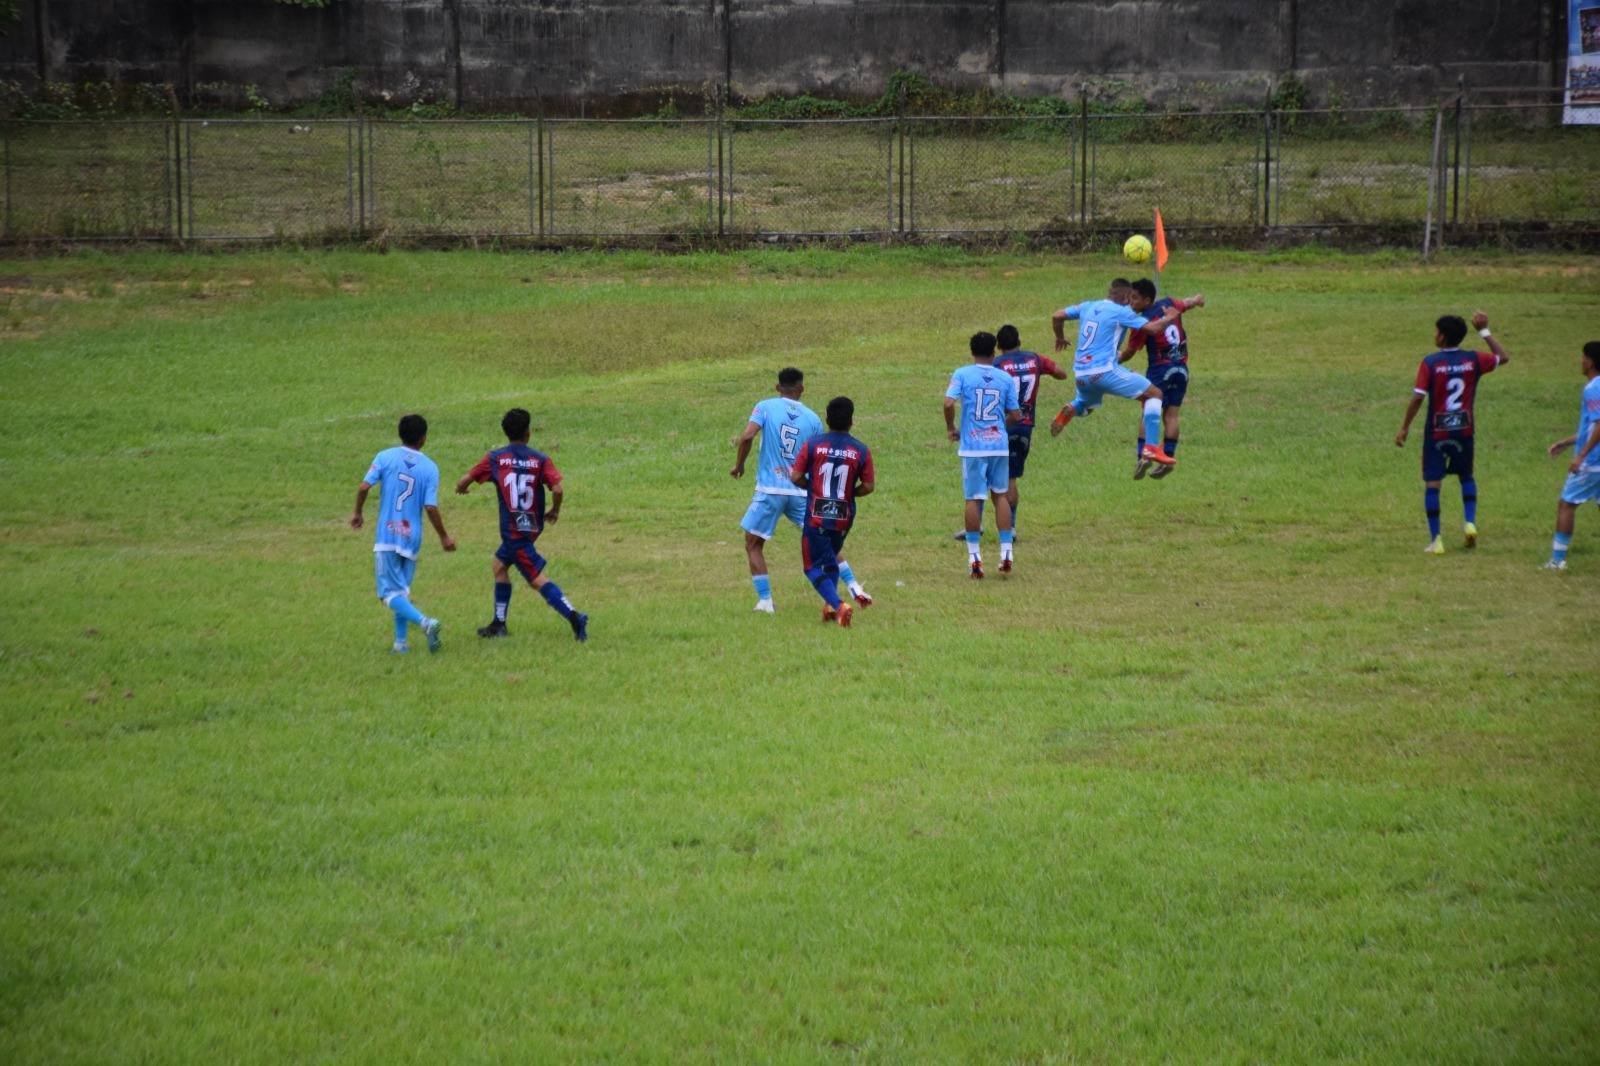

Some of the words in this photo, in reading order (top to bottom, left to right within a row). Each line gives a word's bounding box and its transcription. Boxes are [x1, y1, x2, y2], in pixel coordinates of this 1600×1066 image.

[1080, 321, 1099, 352] 9
[975, 389, 1001, 422] 12
[1446, 378, 1465, 411] 2
[780, 423, 799, 460] 5
[395, 472, 416, 512] 7
[503, 472, 536, 511] 15
[819, 462, 850, 500] 11
